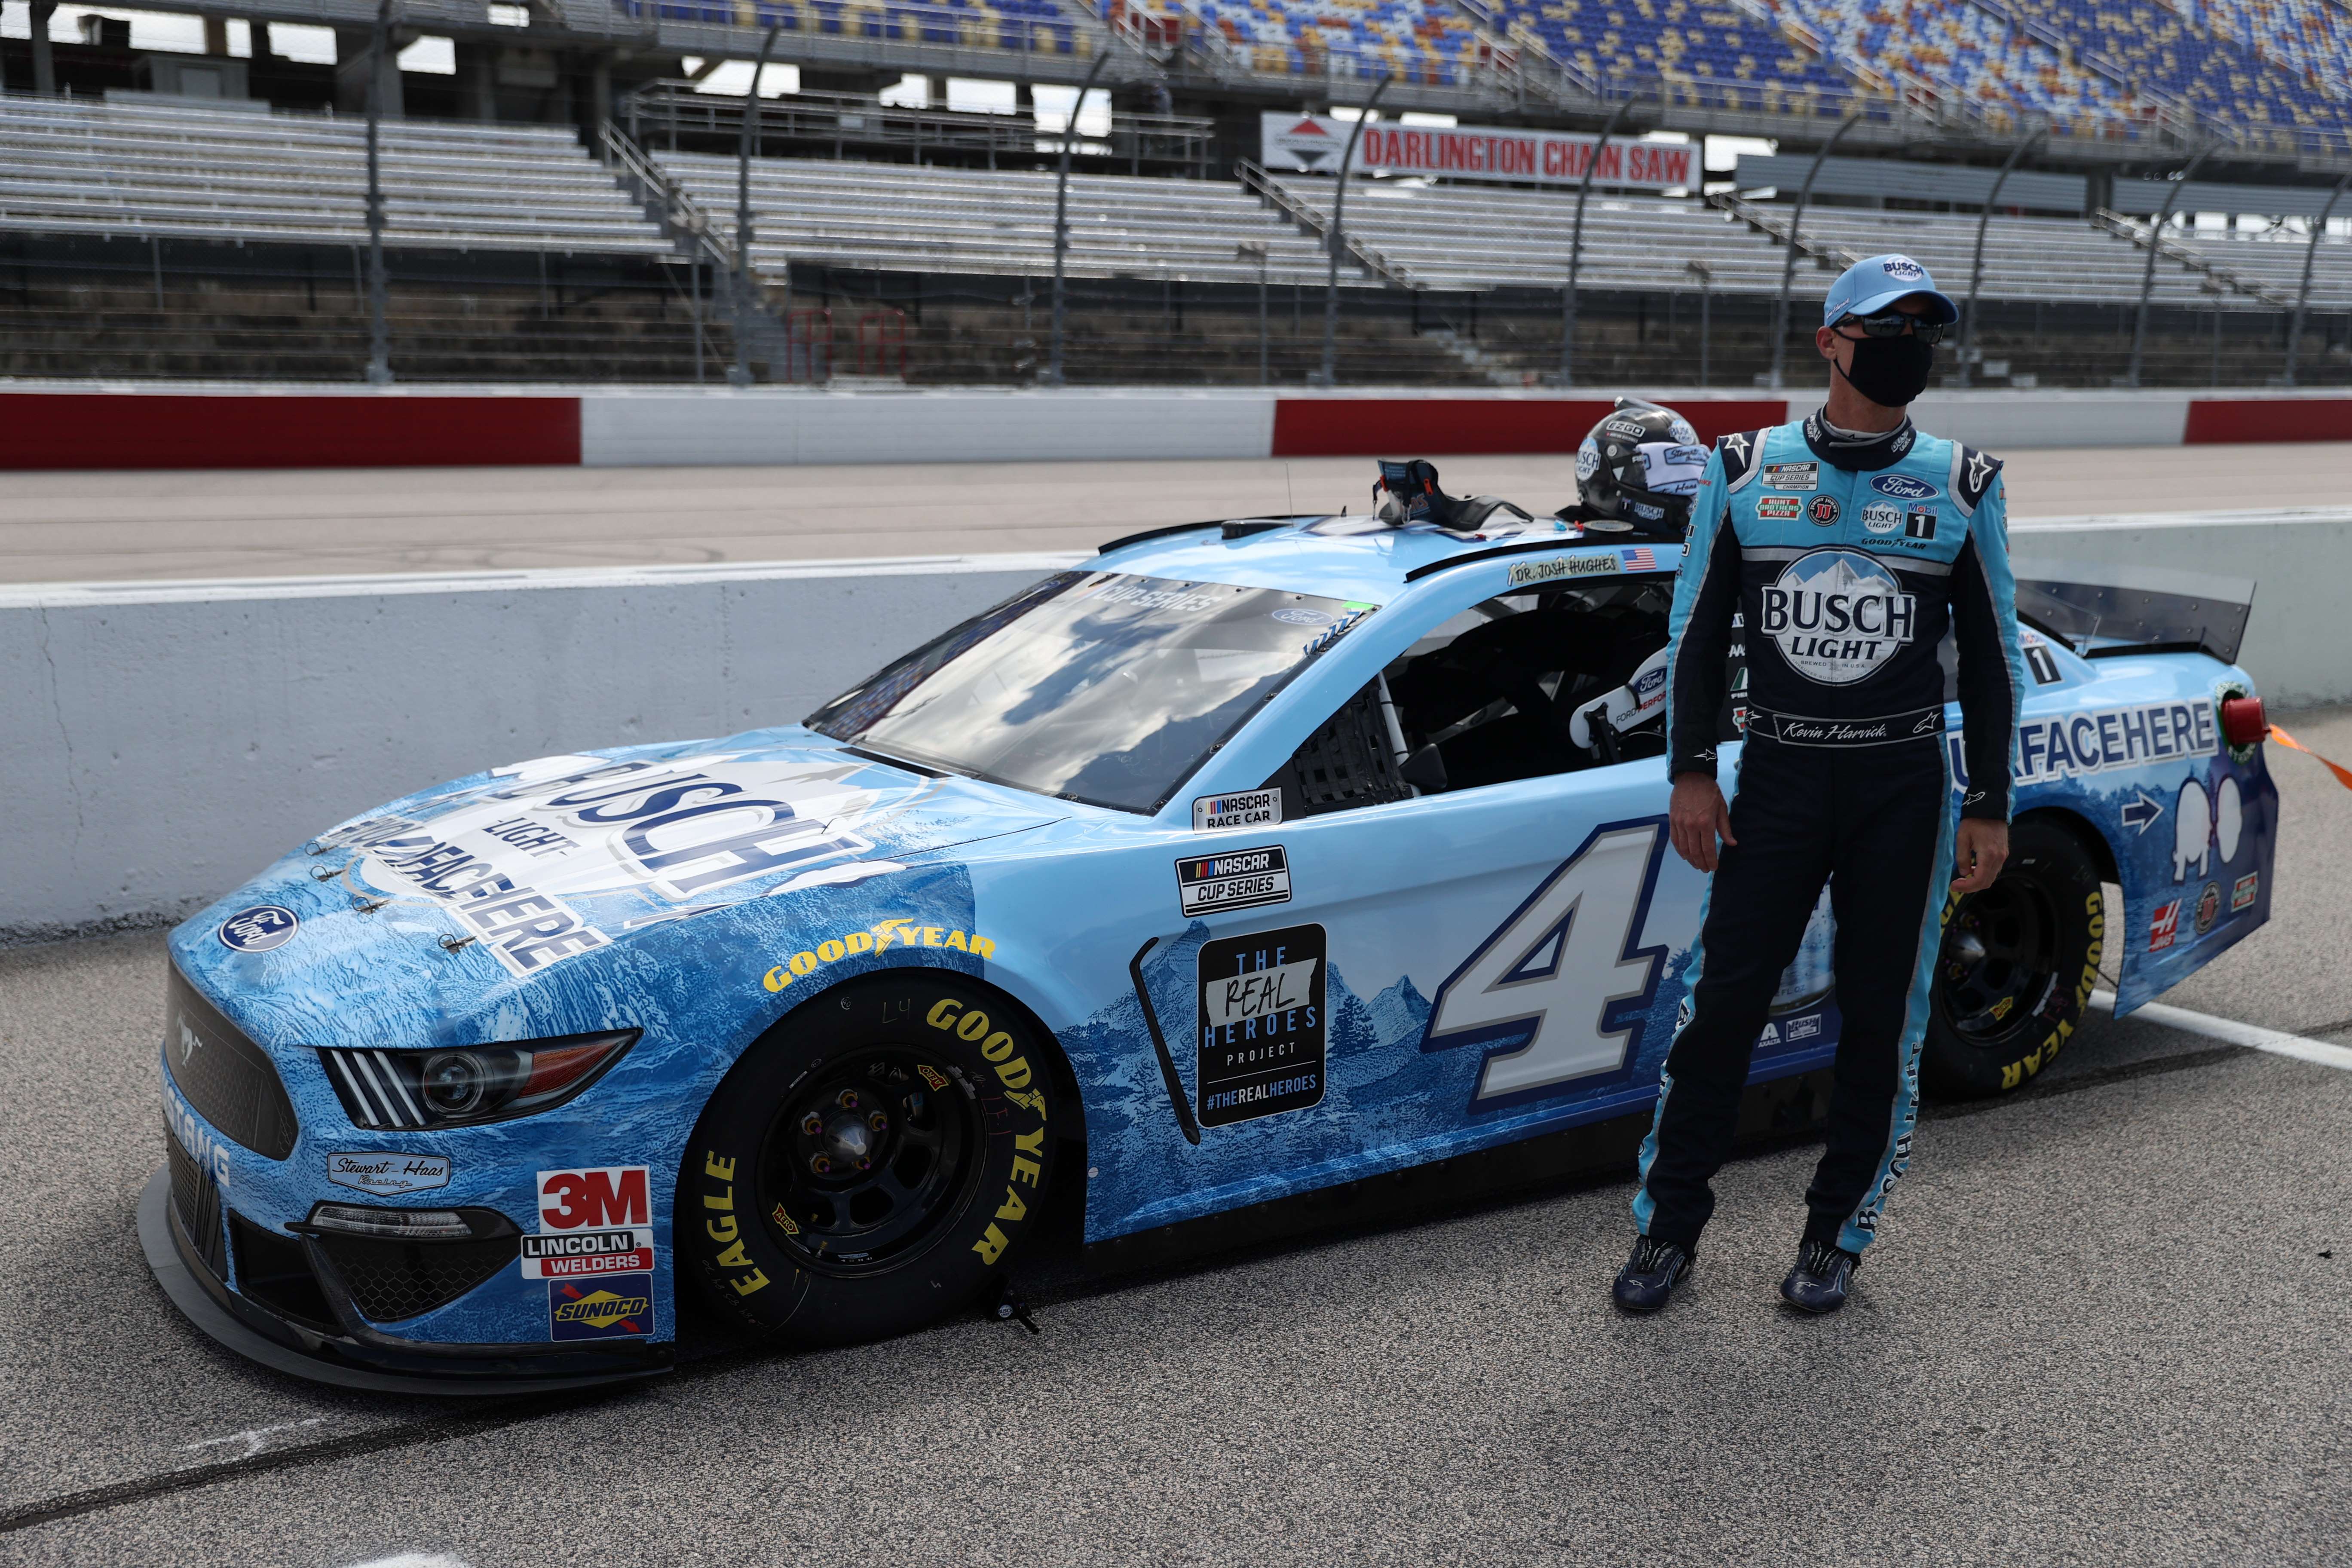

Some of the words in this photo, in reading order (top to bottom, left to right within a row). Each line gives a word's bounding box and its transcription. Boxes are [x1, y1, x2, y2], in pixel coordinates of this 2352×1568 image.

[1364, 128, 1535, 175] DARLINGTON
[1544, 141, 1623, 180] CHAIN
[1629, 146, 1691, 184] SAW
[1883, 262, 1924, 276] BUSCH
[1781, 464, 1810, 472] NASCAR
[1882, 475, 1925, 498] Ford
[1861, 509, 1902, 524] BUSCH
[1908, 502, 1938, 515] Mobil
[1915, 515, 1926, 537] 1
[1861, 538, 1927, 550] GOODYEAR
[1538, 561, 1566, 579] JOSH
[1568, 557, 1617, 575] HUGHES
[1280, 610, 1324, 624] Ford
[1764, 589, 1913, 639] BUSCH
[1790, 636, 1882, 660] LIGHT
[2031, 647, 2052, 682] 1
[1640, 671, 1665, 692] Ford
[1615, 707, 1638, 724] FORD
[1782, 721, 1824, 738] Kevin
[1824, 723, 1886, 740] Harvick
[1951, 702, 2215, 787] UFACEHERE
[1222, 793, 1271, 814] NASCAR
[1207, 814, 1241, 829] RACE
[1244, 810, 1271, 824] CAR
[481, 817, 582, 857] LIGHT
[1213, 853, 1269, 876] NASCAR
[1197, 885, 1225, 901] CUP
[1227, 876, 1274, 897] SERIES
[228, 910, 286, 946] Ford
[763, 923, 996, 992] GOODYEAR
[1236, 946, 1286, 975] THE
[1425, 818, 1664, 1107] 4
[1225, 972, 1296, 1017] REAL
[1204, 1006, 1317, 1048] HEROES
[1227, 1042, 1295, 1066] PROJECT
[922, 1067, 943, 1084] AERO
[1207, 1074, 1317, 1110] #THEREALHEROES
[926, 998, 1046, 1266] GOODYEAR
[358, 1175, 413, 1188] Racing
[542, 1169, 648, 1230] 3M
[703, 1149, 772, 1297] EAGLE
[776, 1211, 795, 1231] AERO
[527, 1234, 629, 1256] LINCOLN
[550, 1254, 640, 1274] WELDERS
[558, 1298, 645, 1320] SUNOCO
